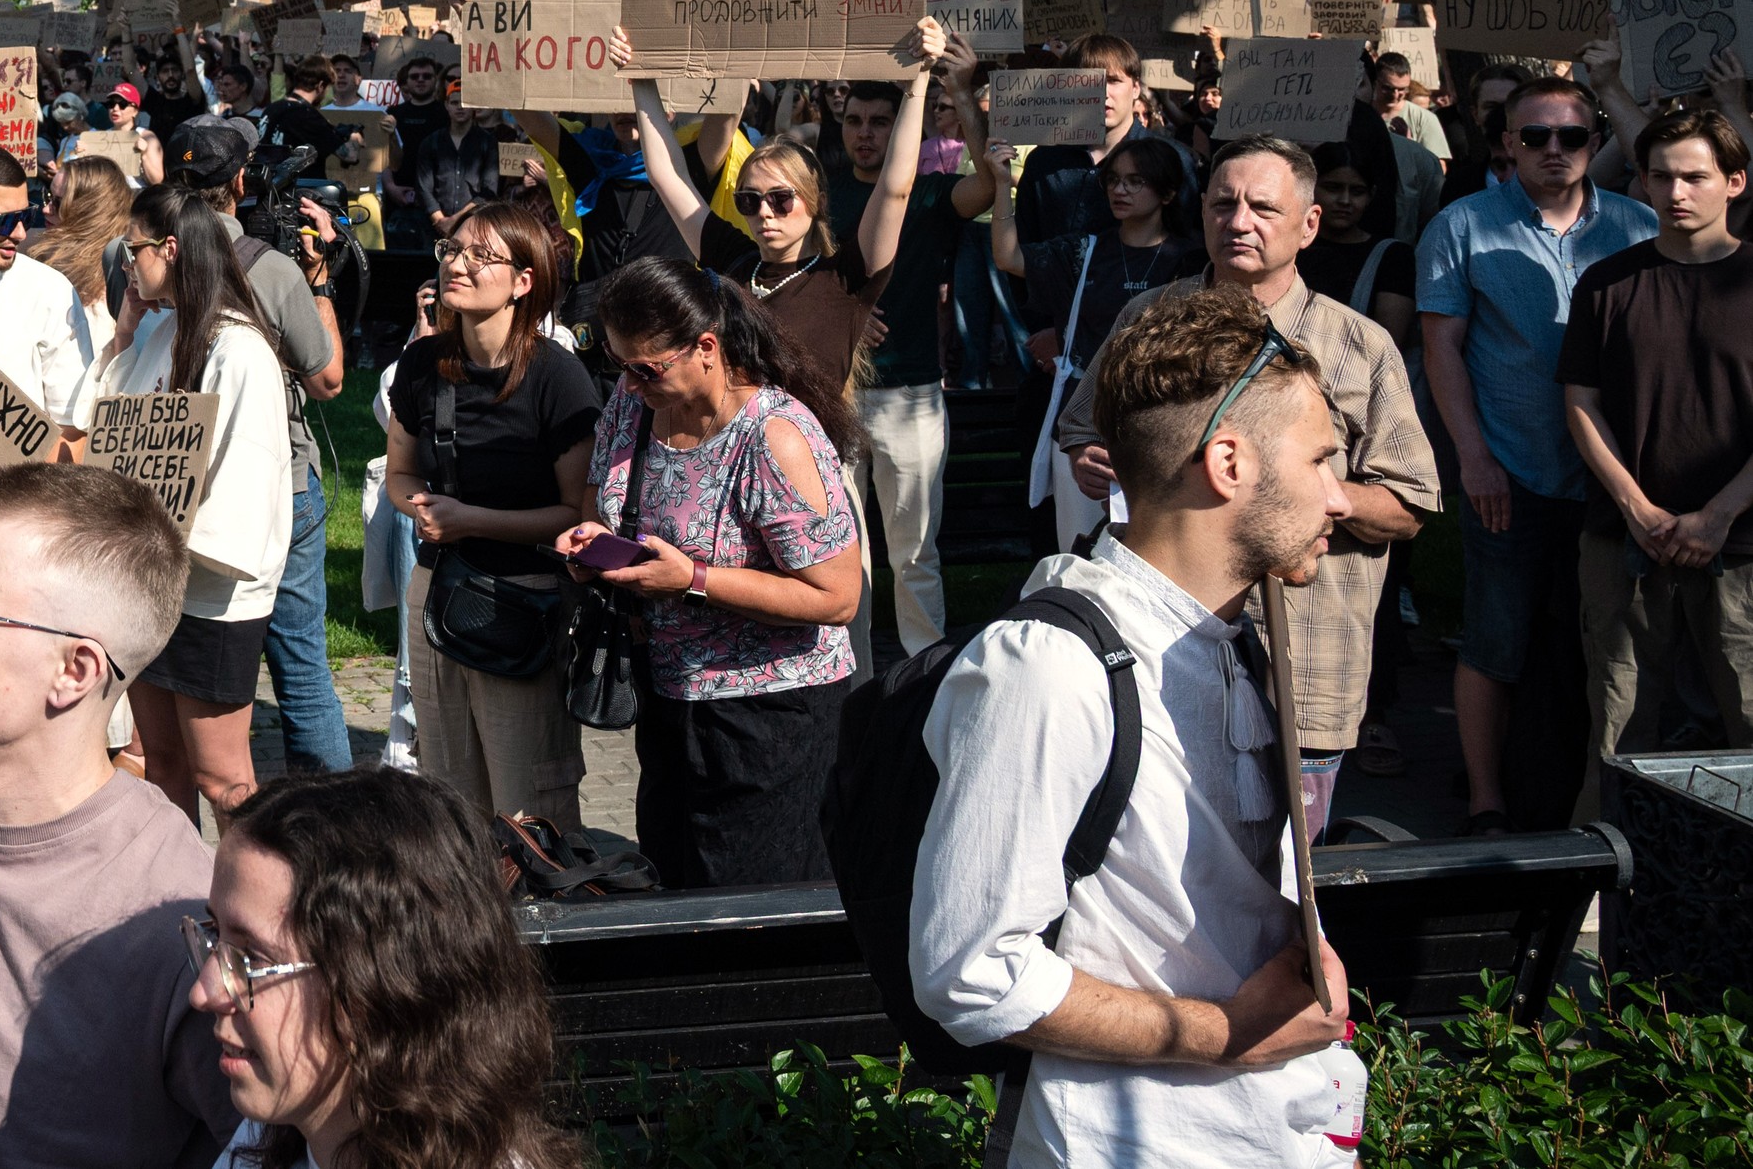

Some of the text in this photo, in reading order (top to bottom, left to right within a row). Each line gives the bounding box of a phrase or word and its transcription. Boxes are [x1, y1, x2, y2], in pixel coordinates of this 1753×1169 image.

[467, 0, 532, 33] А ВИ
[674, 0, 818, 25] ПРОДОВЖИТИ
[469, 35, 606, 73] НА КОГО
[1238, 49, 1315, 70] ВИ ТАМ
[996, 72, 1105, 92] СИЛИ ОБОРОНИ
[150, 396, 189, 423] БУВ
[90, 423, 204, 454] ЄБЕЙШИЙ
[139, 454, 190, 481] СЕБЕ
